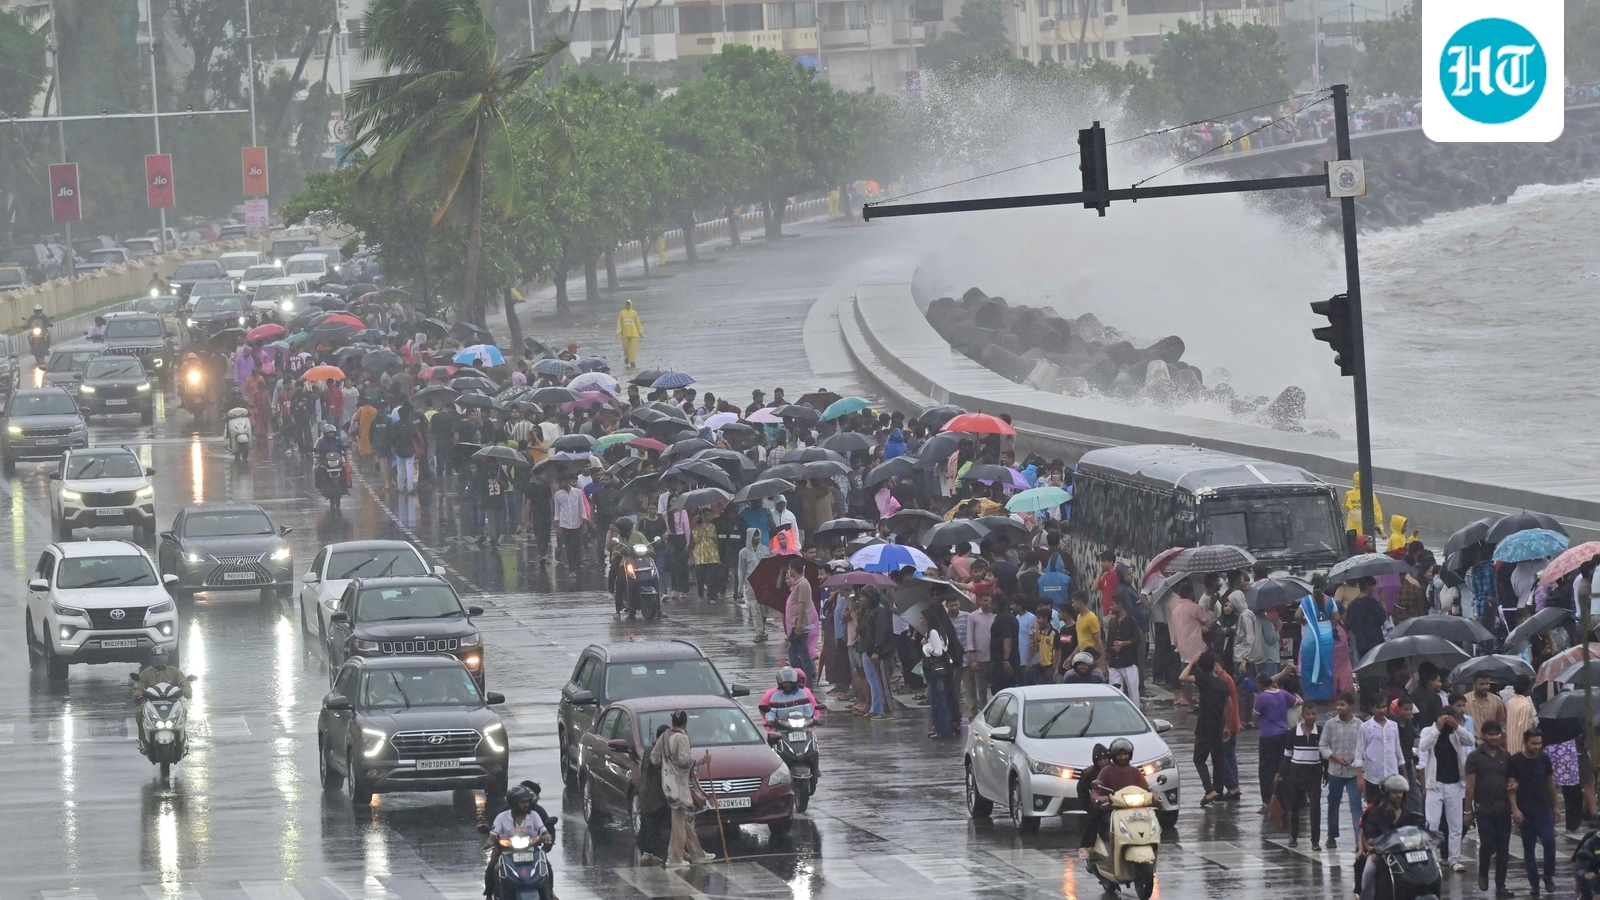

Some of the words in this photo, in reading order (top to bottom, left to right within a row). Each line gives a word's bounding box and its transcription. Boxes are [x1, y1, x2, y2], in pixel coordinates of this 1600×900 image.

[248, 167, 262, 175] Jio
[153, 176, 167, 185] Jio
[57, 187, 73, 197] Jio
[718, 798, 750, 808] 02DW5421
